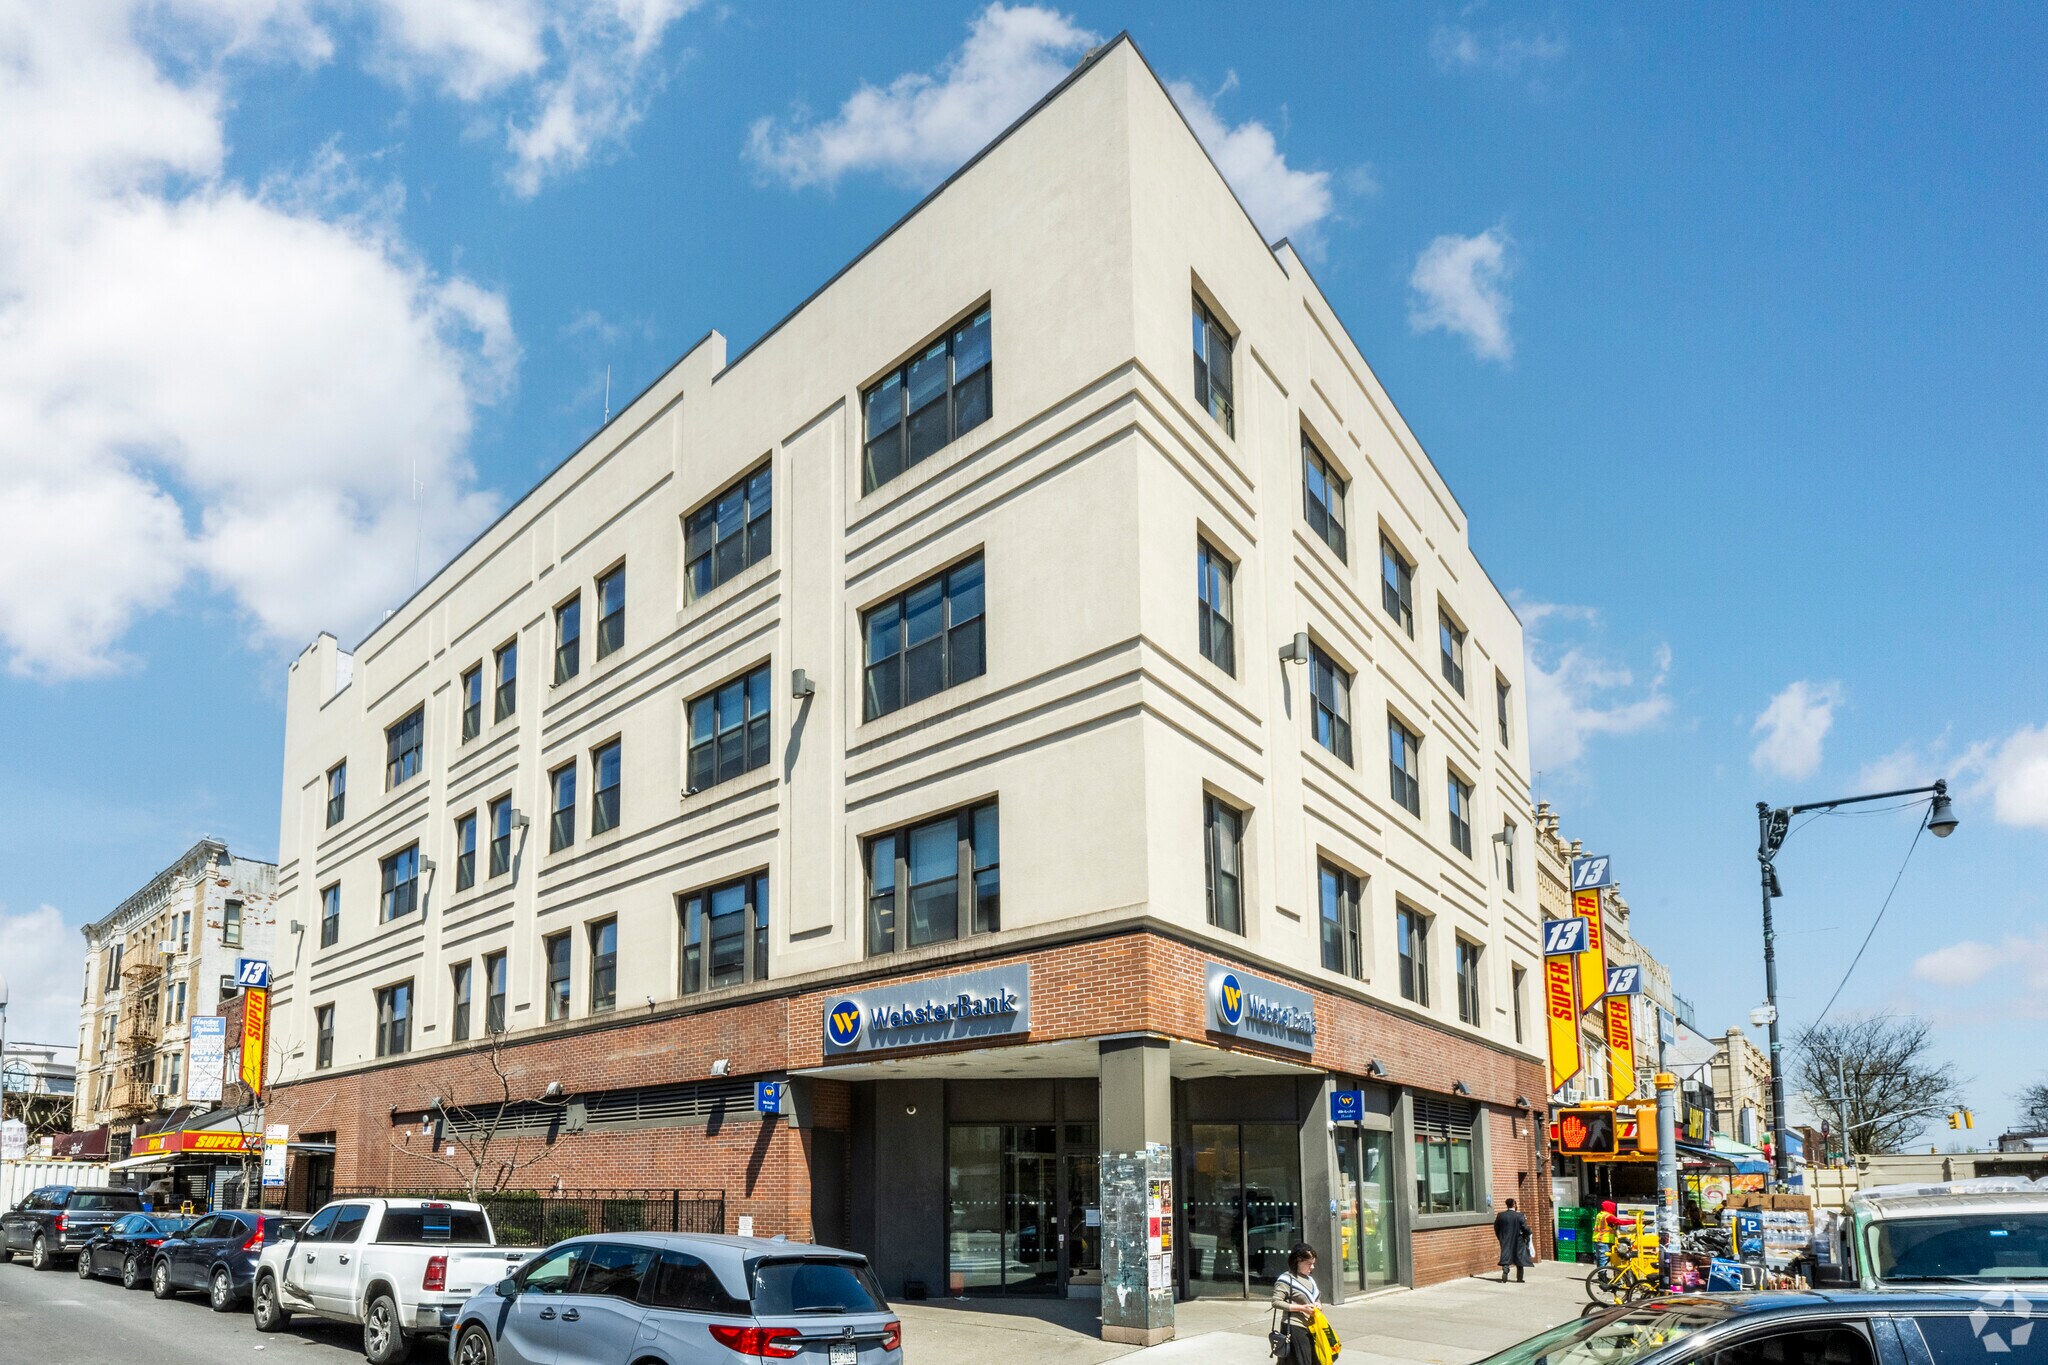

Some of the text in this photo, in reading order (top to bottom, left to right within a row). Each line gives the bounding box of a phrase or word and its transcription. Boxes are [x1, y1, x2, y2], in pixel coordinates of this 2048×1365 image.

[1575, 858, 1608, 888] 13
[1545, 921, 1582, 952] 13
[240, 961, 266, 984] 13
[1607, 968, 1637, 993] 13
[1550, 961, 1572, 1021] SUPER
[247, 991, 262, 1041] SUPER
[1610, 1001, 1629, 1050] SUPER
[195, 1136, 242, 1148] SUPER
